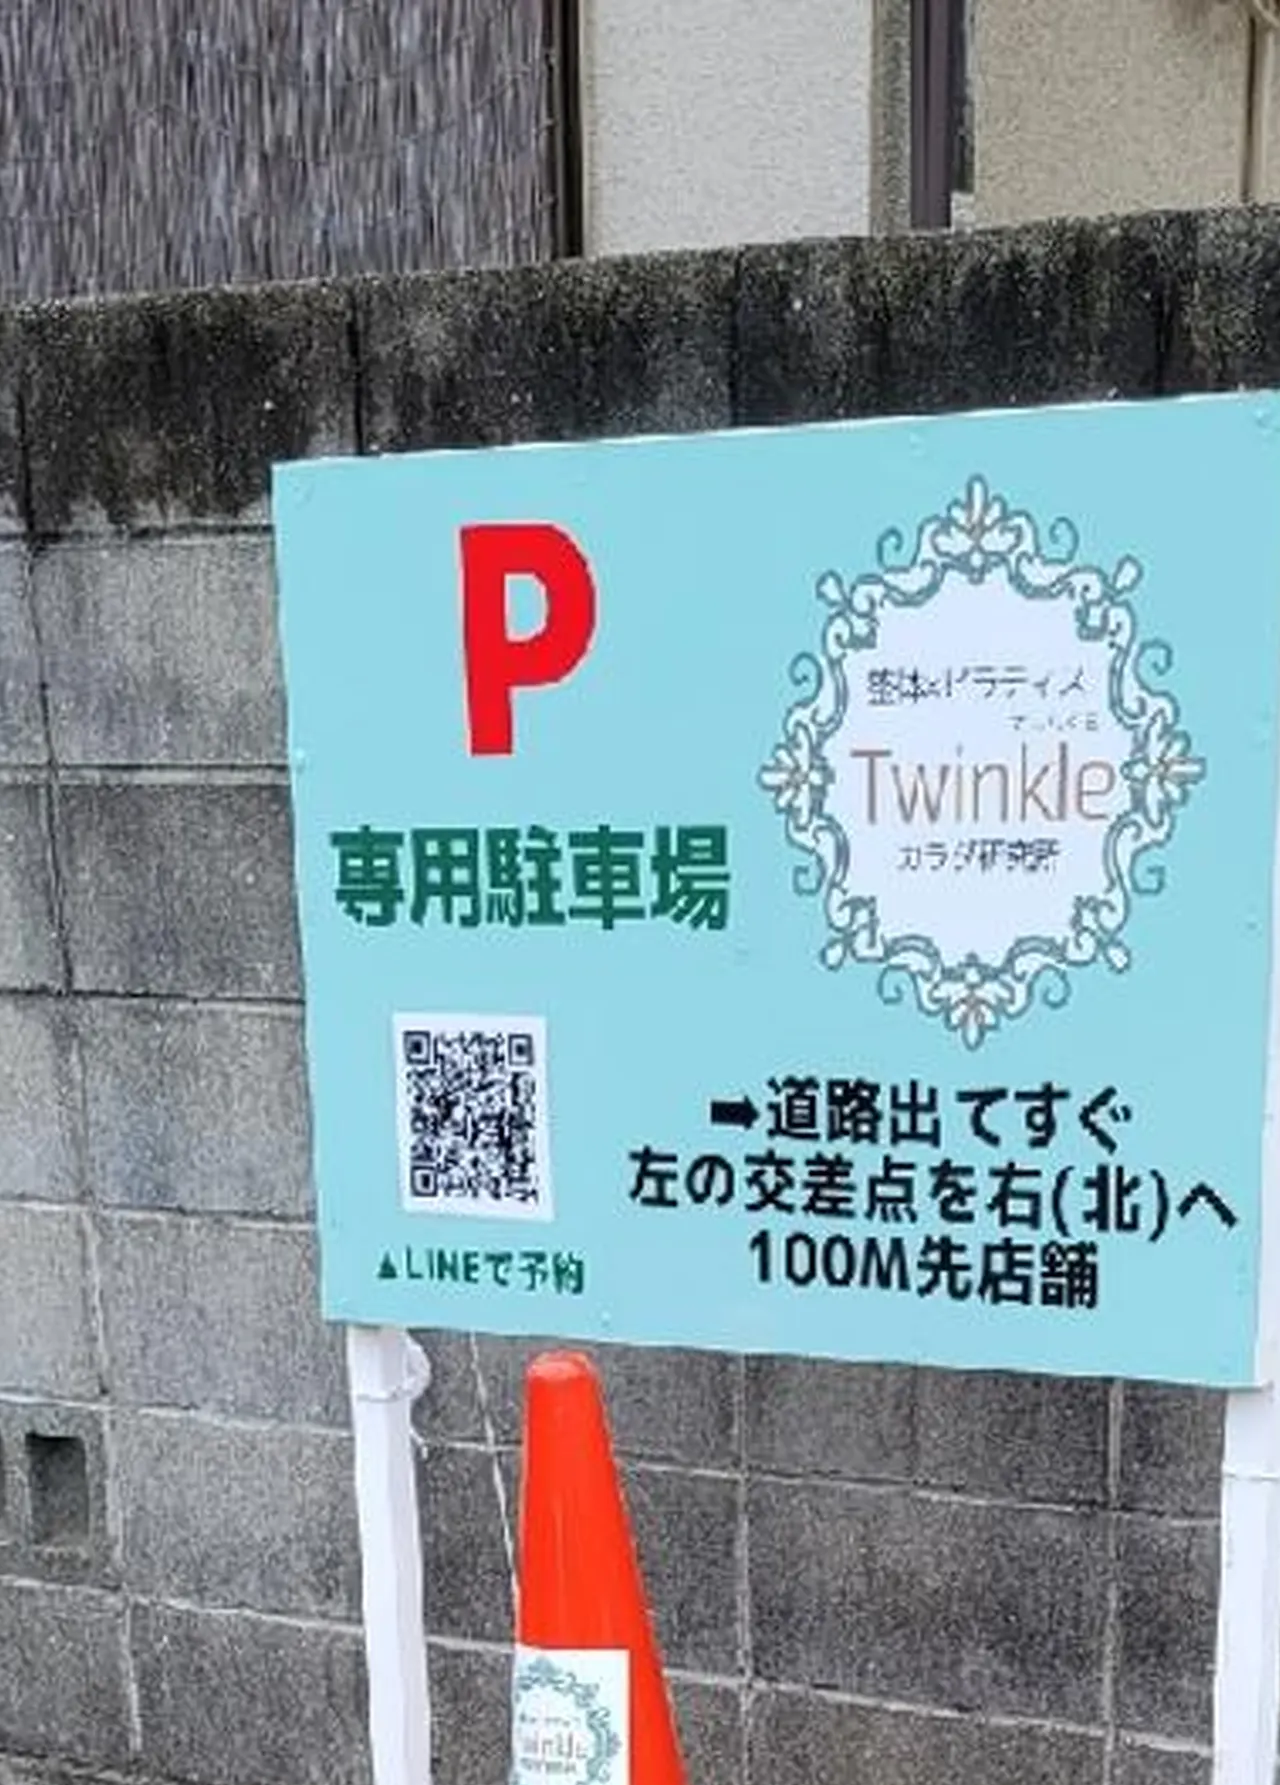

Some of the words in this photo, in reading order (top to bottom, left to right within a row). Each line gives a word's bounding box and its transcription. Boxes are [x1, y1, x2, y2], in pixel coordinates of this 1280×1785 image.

[460, 522, 597, 757] P
[850, 741, 1116, 825] Twinkle
[330, 824, 732, 931] 専用駐車場
[766, 1076, 1134, 1154] 道路出てすぐ
[628, 1145, 1239, 1243] 左の交差点を右(北)へ
[749, 1230, 1099, 1310] 100M先店舗
